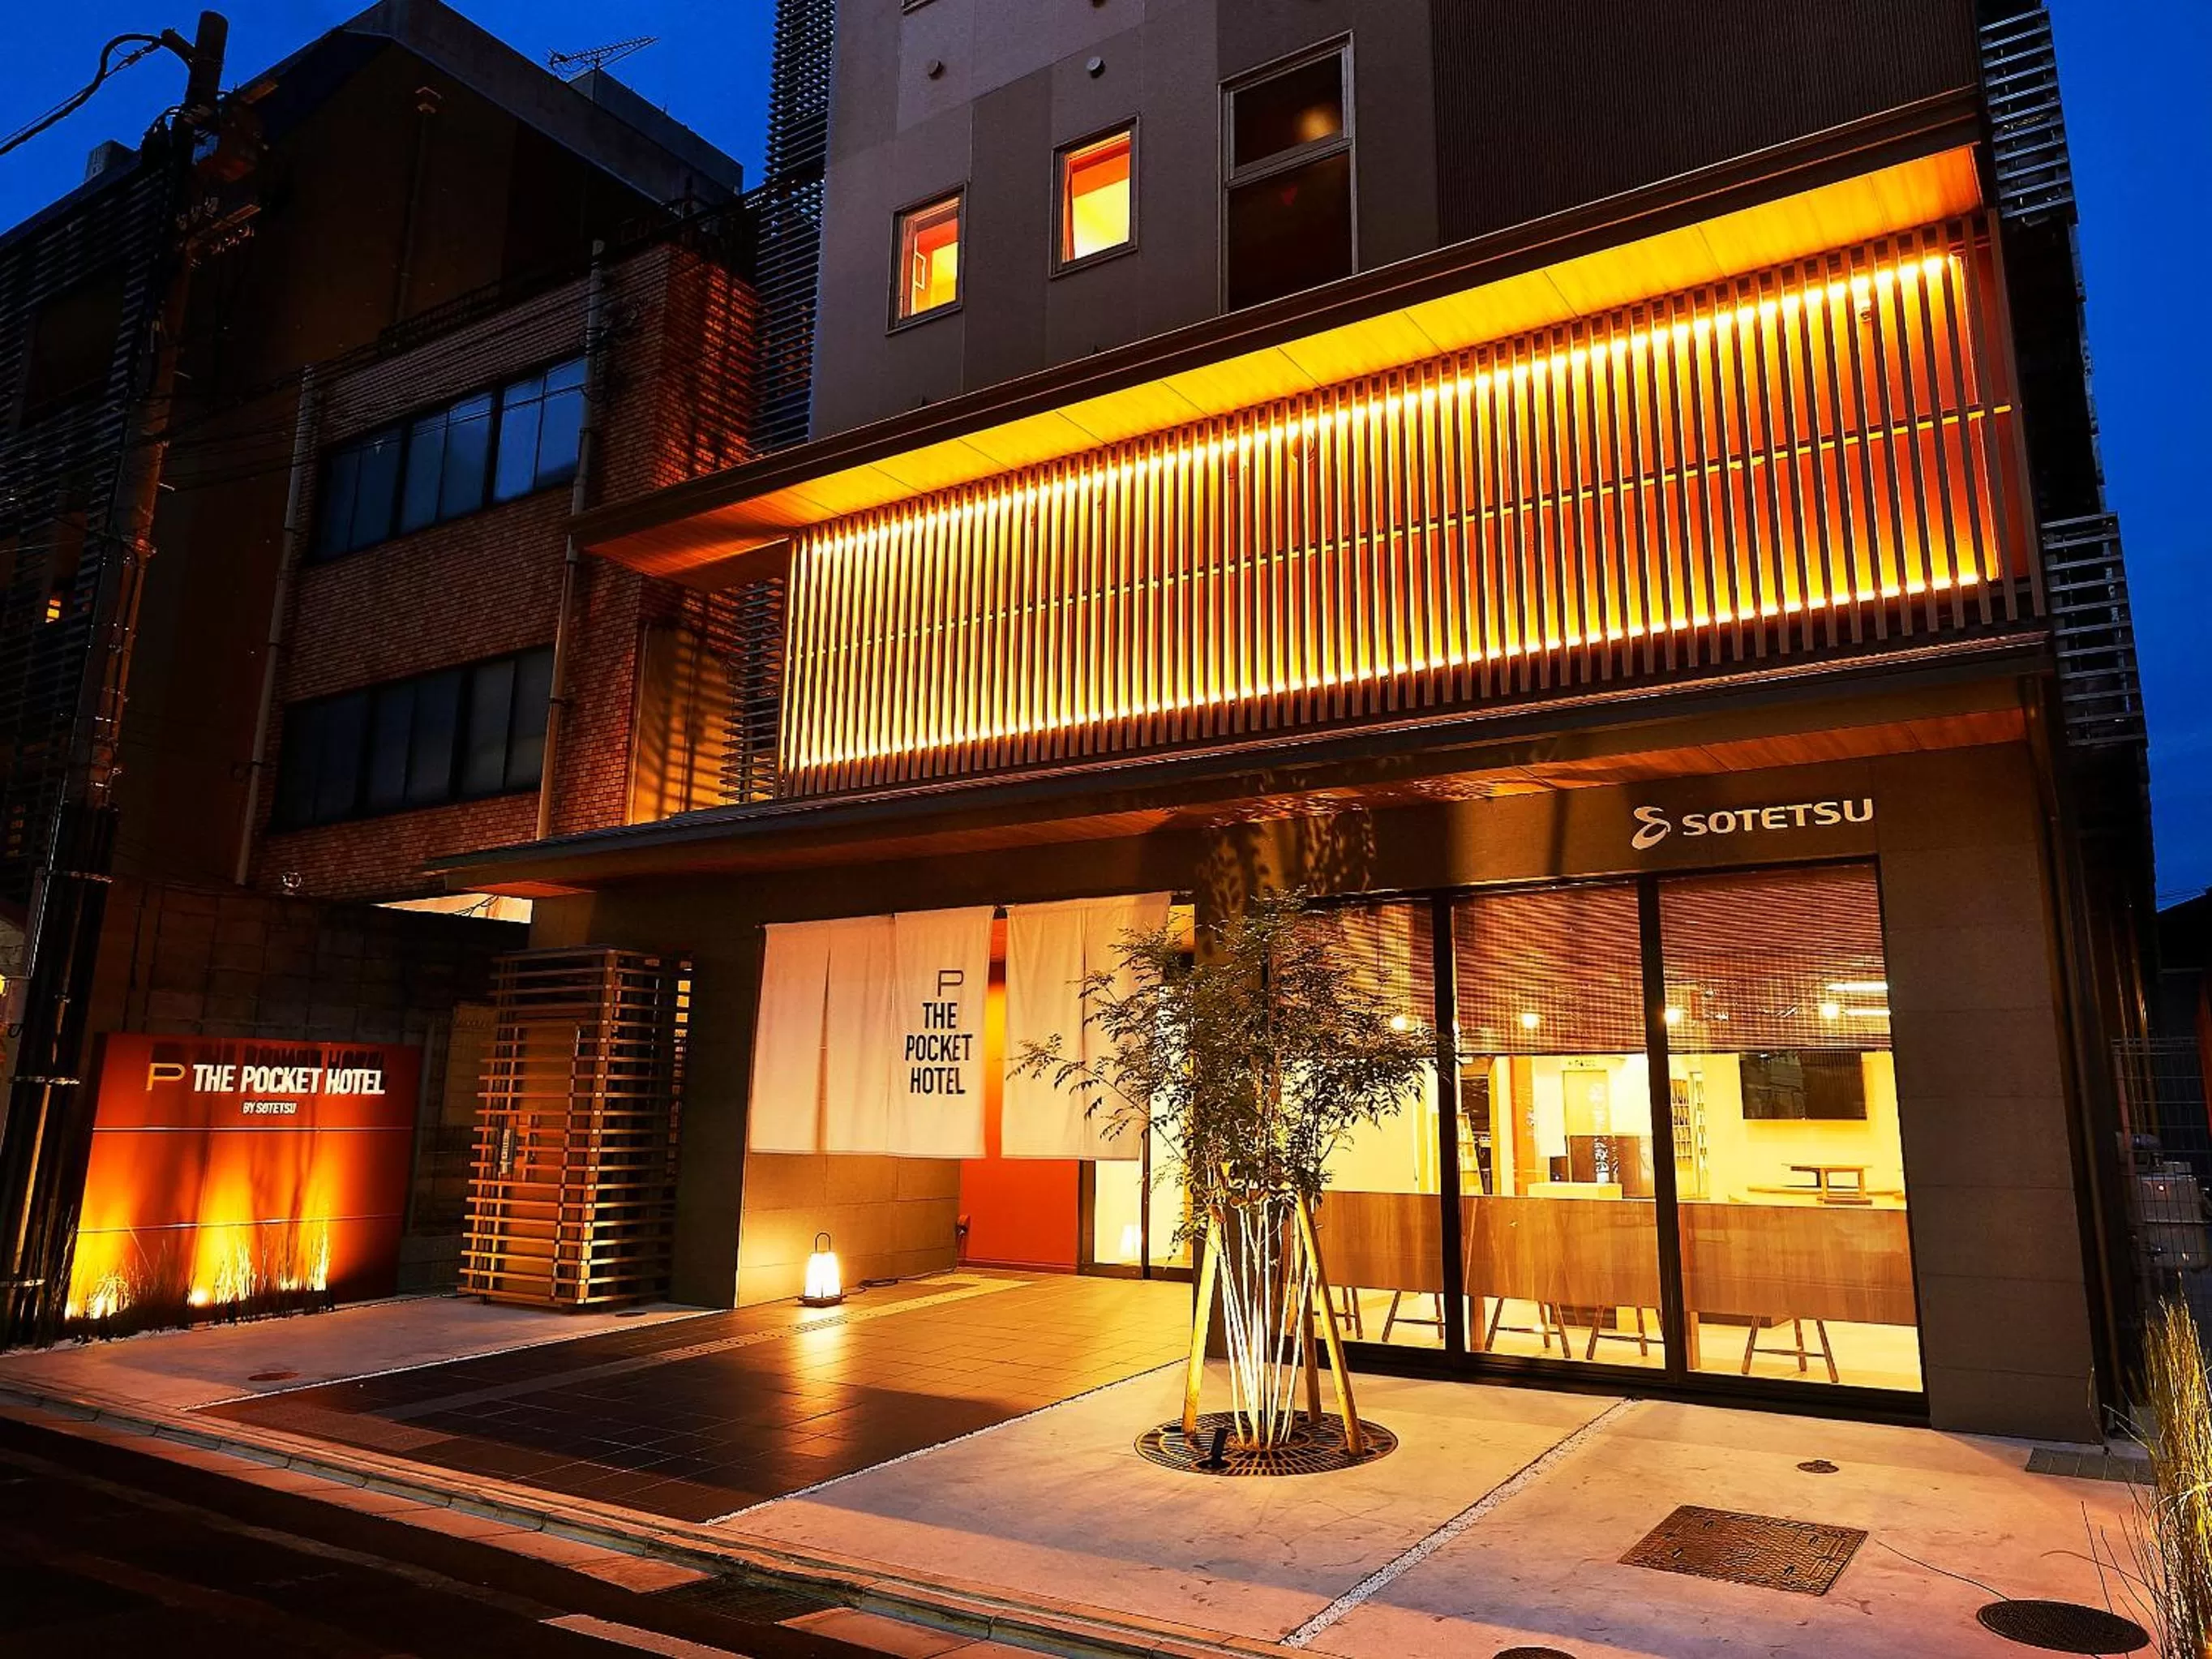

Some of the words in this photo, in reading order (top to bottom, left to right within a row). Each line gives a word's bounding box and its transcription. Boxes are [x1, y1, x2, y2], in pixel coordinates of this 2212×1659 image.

[1682, 799, 1873, 836] SOTETSU
[922, 1002, 958, 1029] THE
[905, 1034, 973, 1061] POCKET
[193, 1064, 237, 1092] THE
[240, 1065, 323, 1094] POCKET
[324, 1069, 385, 1095] HOTEL
[910, 1067, 966, 1095] HOTEL
[243, 1102, 256, 1114] BY
[255, 1102, 297, 1114] SOTETSU
